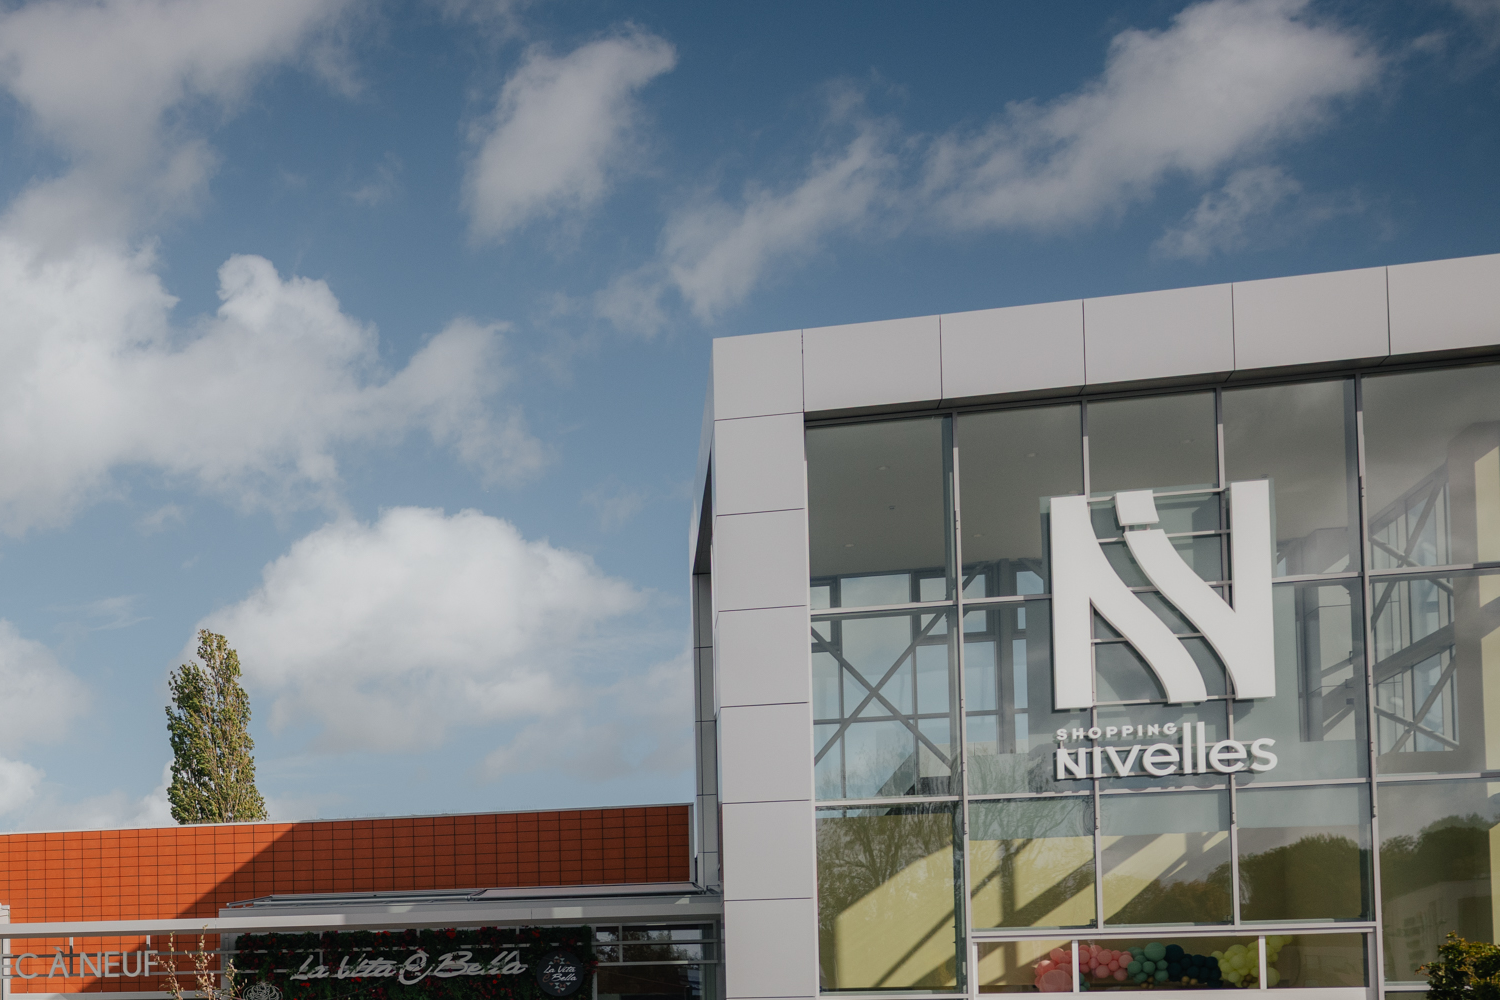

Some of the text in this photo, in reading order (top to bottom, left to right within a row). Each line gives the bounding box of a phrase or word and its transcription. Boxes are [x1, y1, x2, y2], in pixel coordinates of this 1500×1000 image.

[1056, 722, 1178, 741] SHOPPING
[1056, 721, 1278, 780] Nivelles
[48, 946, 70, 979] À
[79, 950, 159, 978] NEUF
[290, 954, 329, 981] La
[337, 953, 398, 980] Vita
[433, 950, 528, 978] Bella
